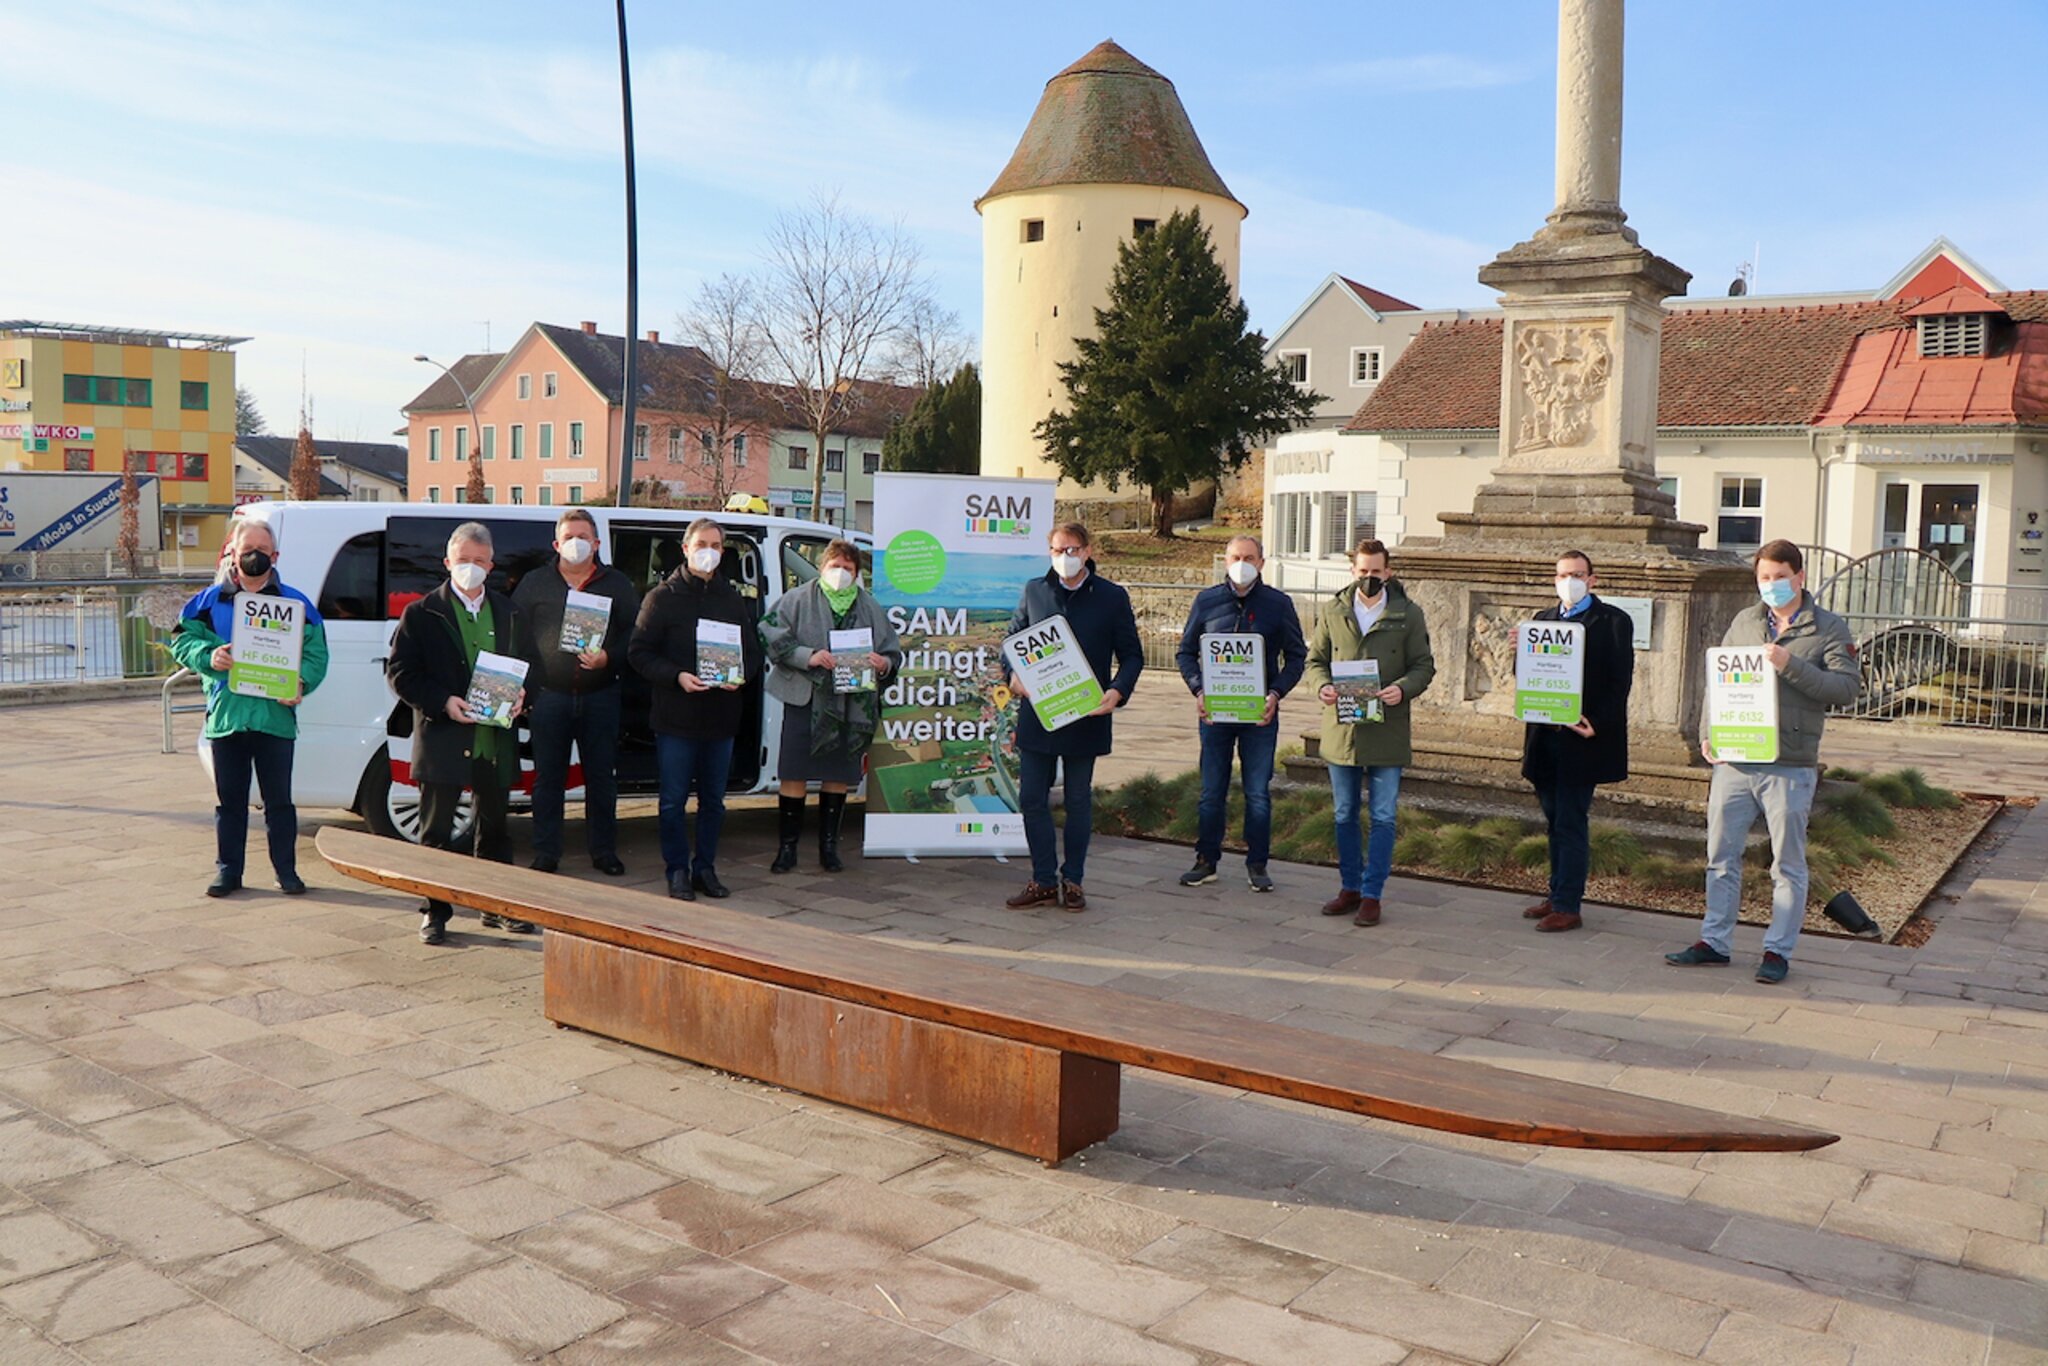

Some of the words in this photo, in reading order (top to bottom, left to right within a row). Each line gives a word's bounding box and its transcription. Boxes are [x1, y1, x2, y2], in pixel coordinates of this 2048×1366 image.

[34, 426, 78, 438] WKO
[1861, 442, 1984, 463] NOTARIAT
[966, 494, 1031, 519] SAM
[40, 521, 73, 547] Made
[84, 486, 125, 517] Swede
[245, 601, 292, 622] SAM
[887, 606, 967, 636] SAM
[1014, 625, 1061, 656] SAM
[1528, 628, 1572, 645] SAM
[1210, 641, 1253, 655] SAM
[242, 650, 258, 660] HF
[262, 654, 289, 666] 6140
[1718, 654, 1763, 672] SAM
[884, 677, 956, 706] dich
[1036, 682, 1054, 696] HF
[1213, 684, 1229, 692] HF
[1230, 684, 1255, 693] 6150
[1527, 678, 1542, 687] HF
[1546, 679, 1571, 690] 6135
[1720, 711, 1736, 721] HF
[1739, 711, 1764, 722] 6132
[883, 712, 997, 741] weiter.
